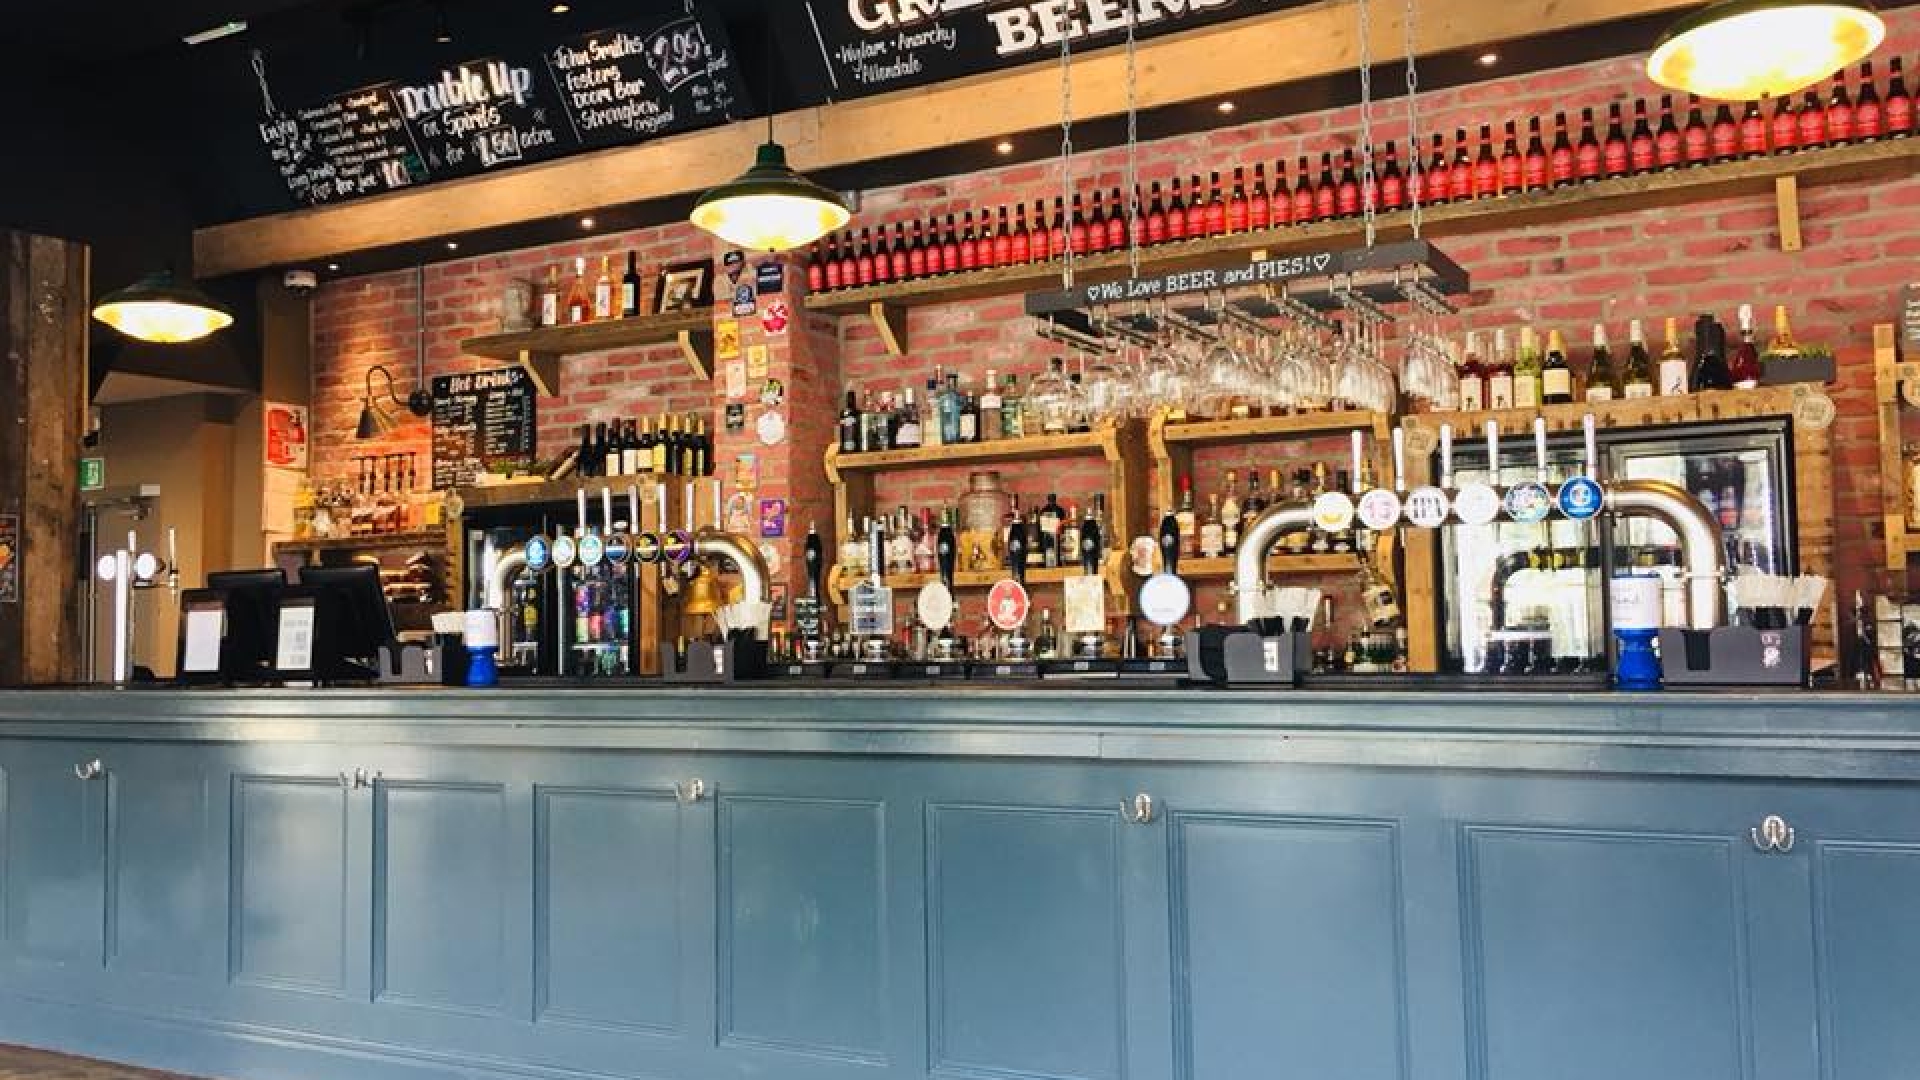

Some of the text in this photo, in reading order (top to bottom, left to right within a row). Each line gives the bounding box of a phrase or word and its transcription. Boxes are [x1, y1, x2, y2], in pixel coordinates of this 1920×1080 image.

[898, 22, 956, 51] Anarchy
[398, 65, 490, 119] Double
[1101, 281, 1123, 299] We
[1126, 278, 1162, 297] Love
[1166, 269, 1217, 293] BEER
[1223, 263, 1254, 284] and
